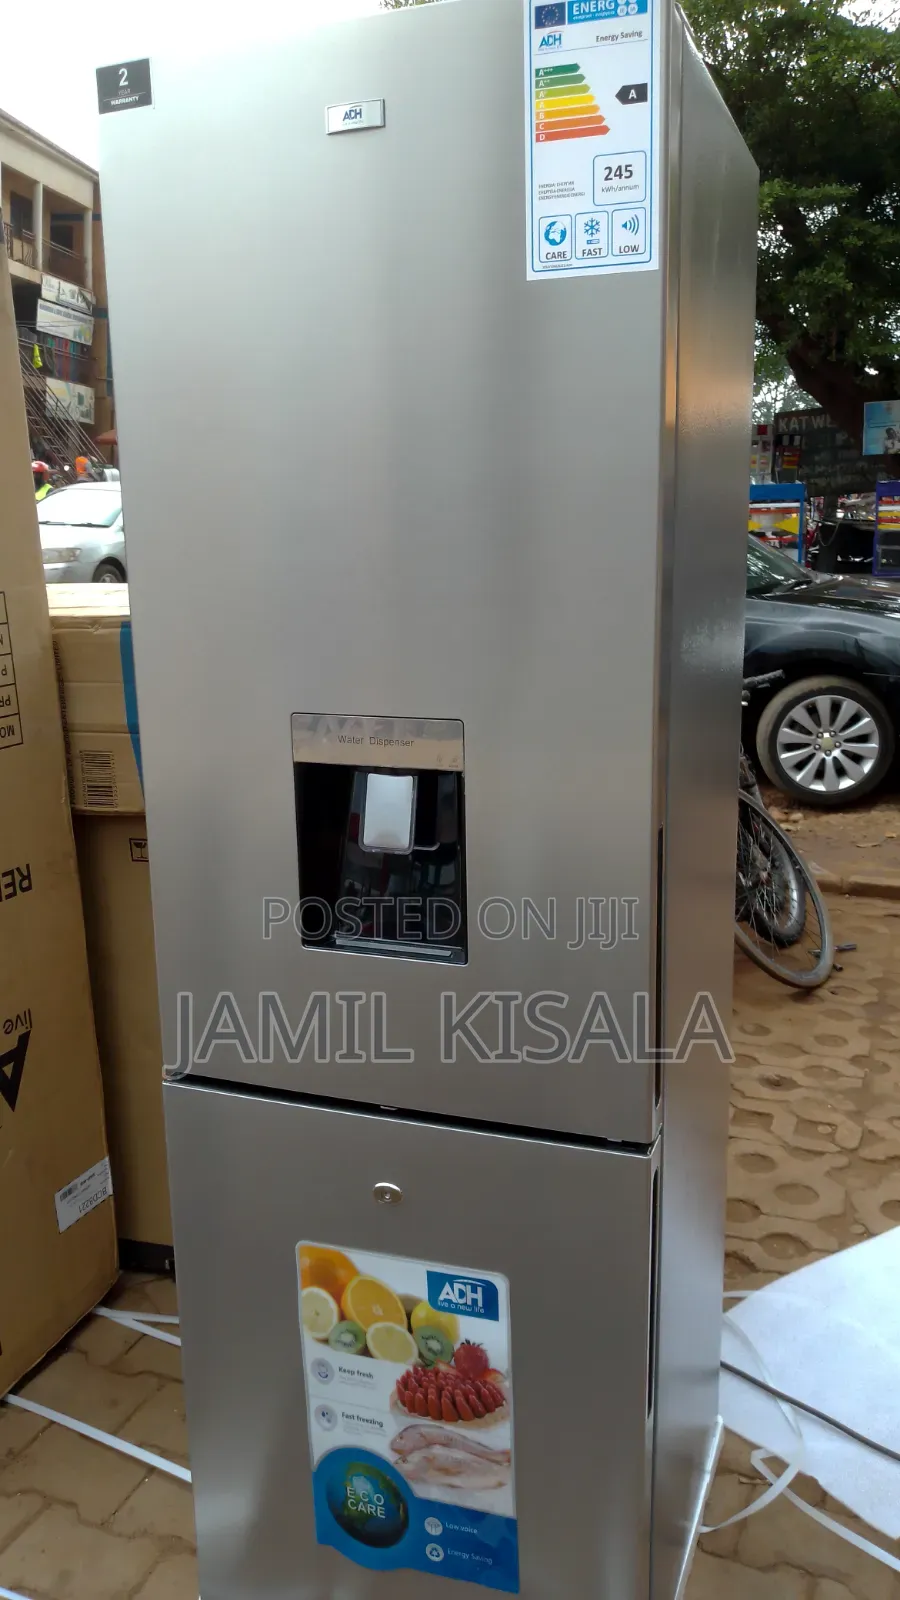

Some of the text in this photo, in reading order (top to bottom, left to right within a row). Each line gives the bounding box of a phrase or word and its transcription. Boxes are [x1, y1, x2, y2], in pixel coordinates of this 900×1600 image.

[573, 0, 615, 15] ENERG
[596, 30, 643, 44] Energy Saving
[118, 67, 129, 87] 2
[110, 95, 140, 106] WARRANTY
[628, 88, 638, 100] A
[539, 112, 545, 120] B
[539, 122, 545, 131] C
[539, 133, 546, 141] D
[603, 164, 634, 182] 245
[601, 183, 640, 194] kWh/annum
[545, 250, 568, 261] CARE
[582, 247, 603, 258] FAST
[619, 244, 640, 254] LOW
[338, 735, 415, 748] Water Dispenser
[0, 863, 33, 901] RE
[3, 1008, 32, 1034] live
[438, 1281, 483, 1307] ADH
[457, 1304, 472, 1312] new
[474, 1306, 485, 1314] life
[338, 1366, 374, 1380] Keep fresh
[341, 1412, 384, 1428] Fast freezing
[348, 1500, 386, 1519] CARE
[445, 1521, 478, 1535] Low voice
[447, 1549, 493, 1565] Energy Saving
